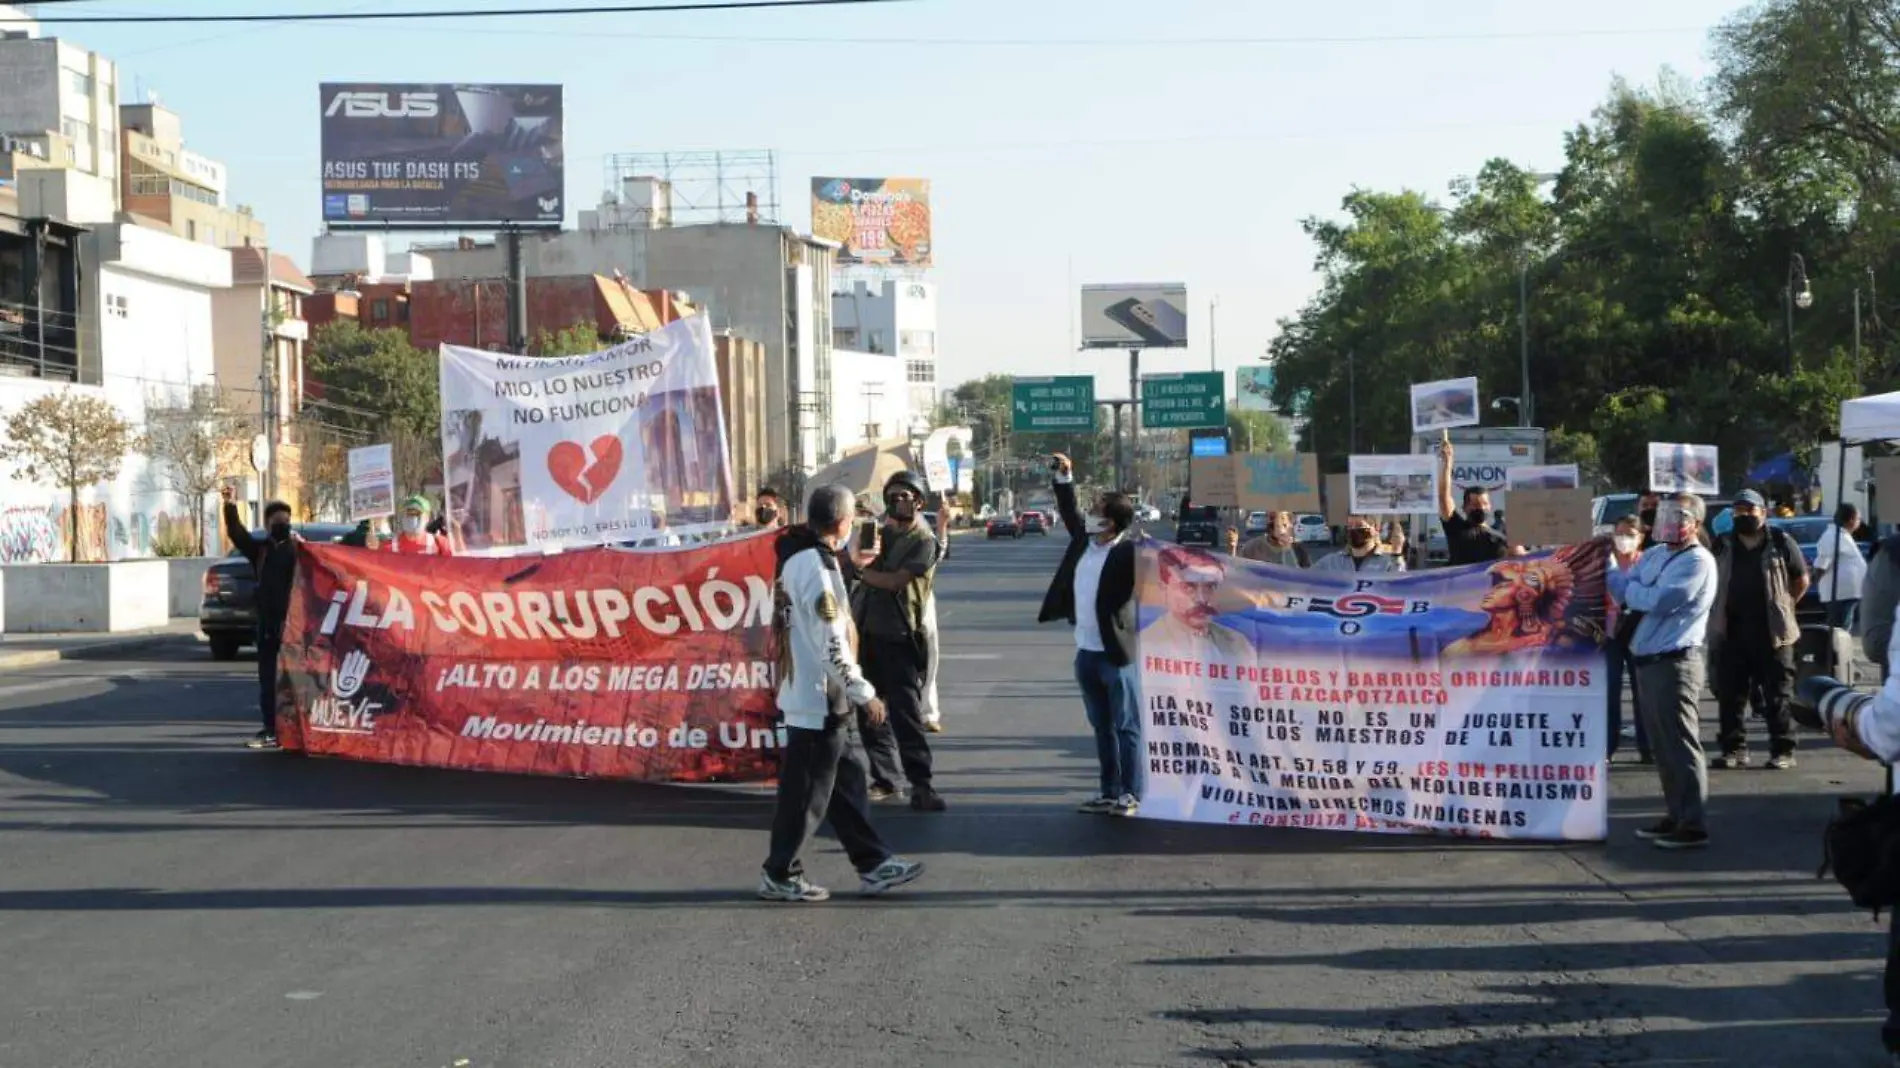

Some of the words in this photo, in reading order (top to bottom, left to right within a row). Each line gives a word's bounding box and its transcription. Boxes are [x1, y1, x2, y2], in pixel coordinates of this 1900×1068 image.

[325, 92, 438, 117] ASUS
[324, 162, 366, 179] ASUS
[372, 162, 400, 179] TUF
[406, 162, 448, 179] DASH
[454, 162, 479, 179] F15
[544, 378, 567, 396] LO
[574, 360, 663, 393] NUESTRO
[514, 407, 544, 424] NO
[550, 391, 649, 422] FUNCIONA
[1450, 466, 1506, 481] ANON
[1355, 580, 1373, 592] P
[320, 579, 415, 634] ¡LA
[420, 567, 775, 640] CORRUPCIÓN
[1286, 597, 1303, 608] F
[1411, 601, 1430, 614] B
[1340, 620, 1361, 635] O
[436, 663, 517, 692] ¡ALTO
[522, 665, 540, 690] A
[549, 665, 601, 691] LOS
[607, 665, 679, 691] MEGA
[686, 661, 776, 691] DESAR
[1145, 656, 1202, 677] FRENTE
[1209, 663, 1229, 680] DE
[1236, 666, 1321, 686] PUEBLOS
[1329, 671, 1339, 686] Y
[1347, 672, 1443, 688] BARRIOS
[1451, 670, 1591, 687] ORIGINARIOS
[1260, 685, 1284, 701] DE
[1291, 688, 1449, 706] AZCAPOTZALCO
[310, 697, 383, 728] MUEVE
[1151, 695, 1177, 711] ¡LA
[1186, 698, 1214, 717] PAZ
[1318, 710, 1344, 726] NO
[1366, 712, 1389, 726] ES
[1410, 713, 1436, 728] UN
[1463, 713, 1548, 729] JUGUETE
[1572, 713, 1584, 729] Y
[460, 716, 658, 748] Movimiento
[668, 721, 708, 748] de
[1153, 711, 1209, 731] MENOS
[1229, 721, 1250, 737] DE
[1267, 725, 1301, 741] LOS
[1316, 727, 1425, 746] MAESTROS
[1445, 731, 1471, 746] DE
[1489, 731, 1513, 747] LA
[1541, 731, 1585, 748] LEY!
[1148, 741, 1220, 760] NORMAS
[1226, 749, 1244, 766] AL
[1250, 753, 1287, 771] ART.
[1356, 761, 1367, 774] Y
[1372, 761, 1404, 776] 59.
[1458, 763, 1485, 778] UN
[1495, 763, 1597, 781] PELIGRO!
[1151, 759, 1221, 776] HECHAS
[1232, 766, 1241, 780] A
[1251, 770, 1269, 786] LA
[1280, 774, 1354, 790] MEDIDA
[1367, 777, 1404, 790] DEL
[1410, 777, 1593, 801] NEOLIBERALISMO
[1201, 784, 1301, 810] VIOLENTAN
[1308, 797, 1405, 818] DERECHOS
[1413, 802, 1528, 827] INDÍGENAS
